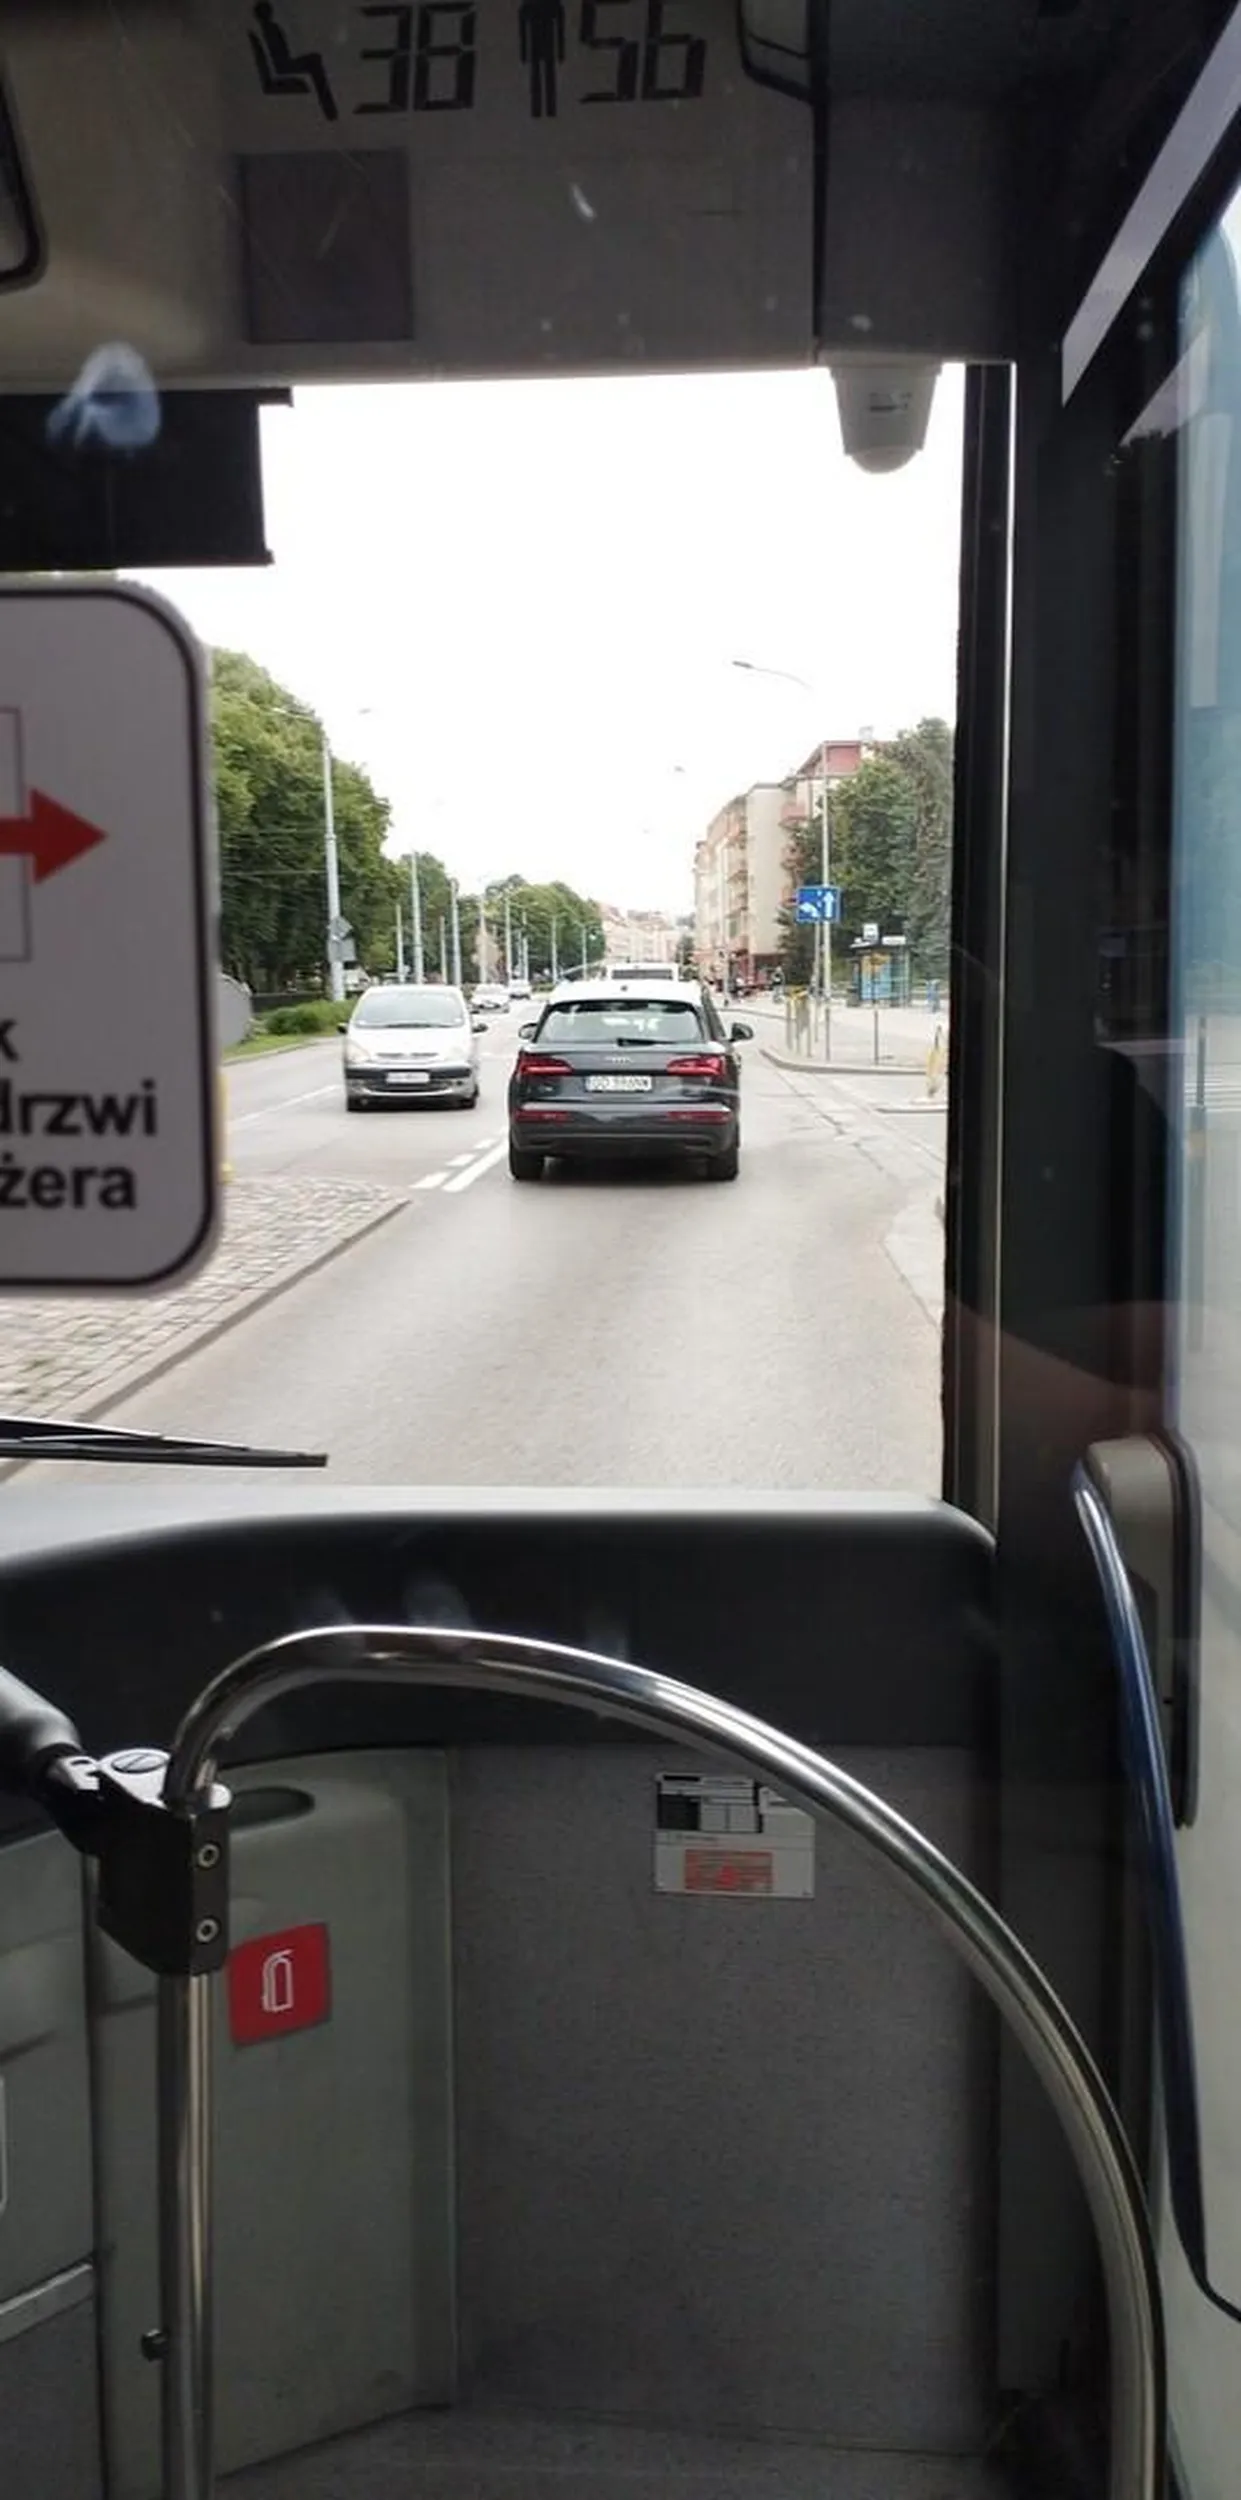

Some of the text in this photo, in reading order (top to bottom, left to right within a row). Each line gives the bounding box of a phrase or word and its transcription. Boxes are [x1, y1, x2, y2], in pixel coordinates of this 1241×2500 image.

[352, 0, 707, 114] 38 56
[0, 1152, 136, 1210] żera
